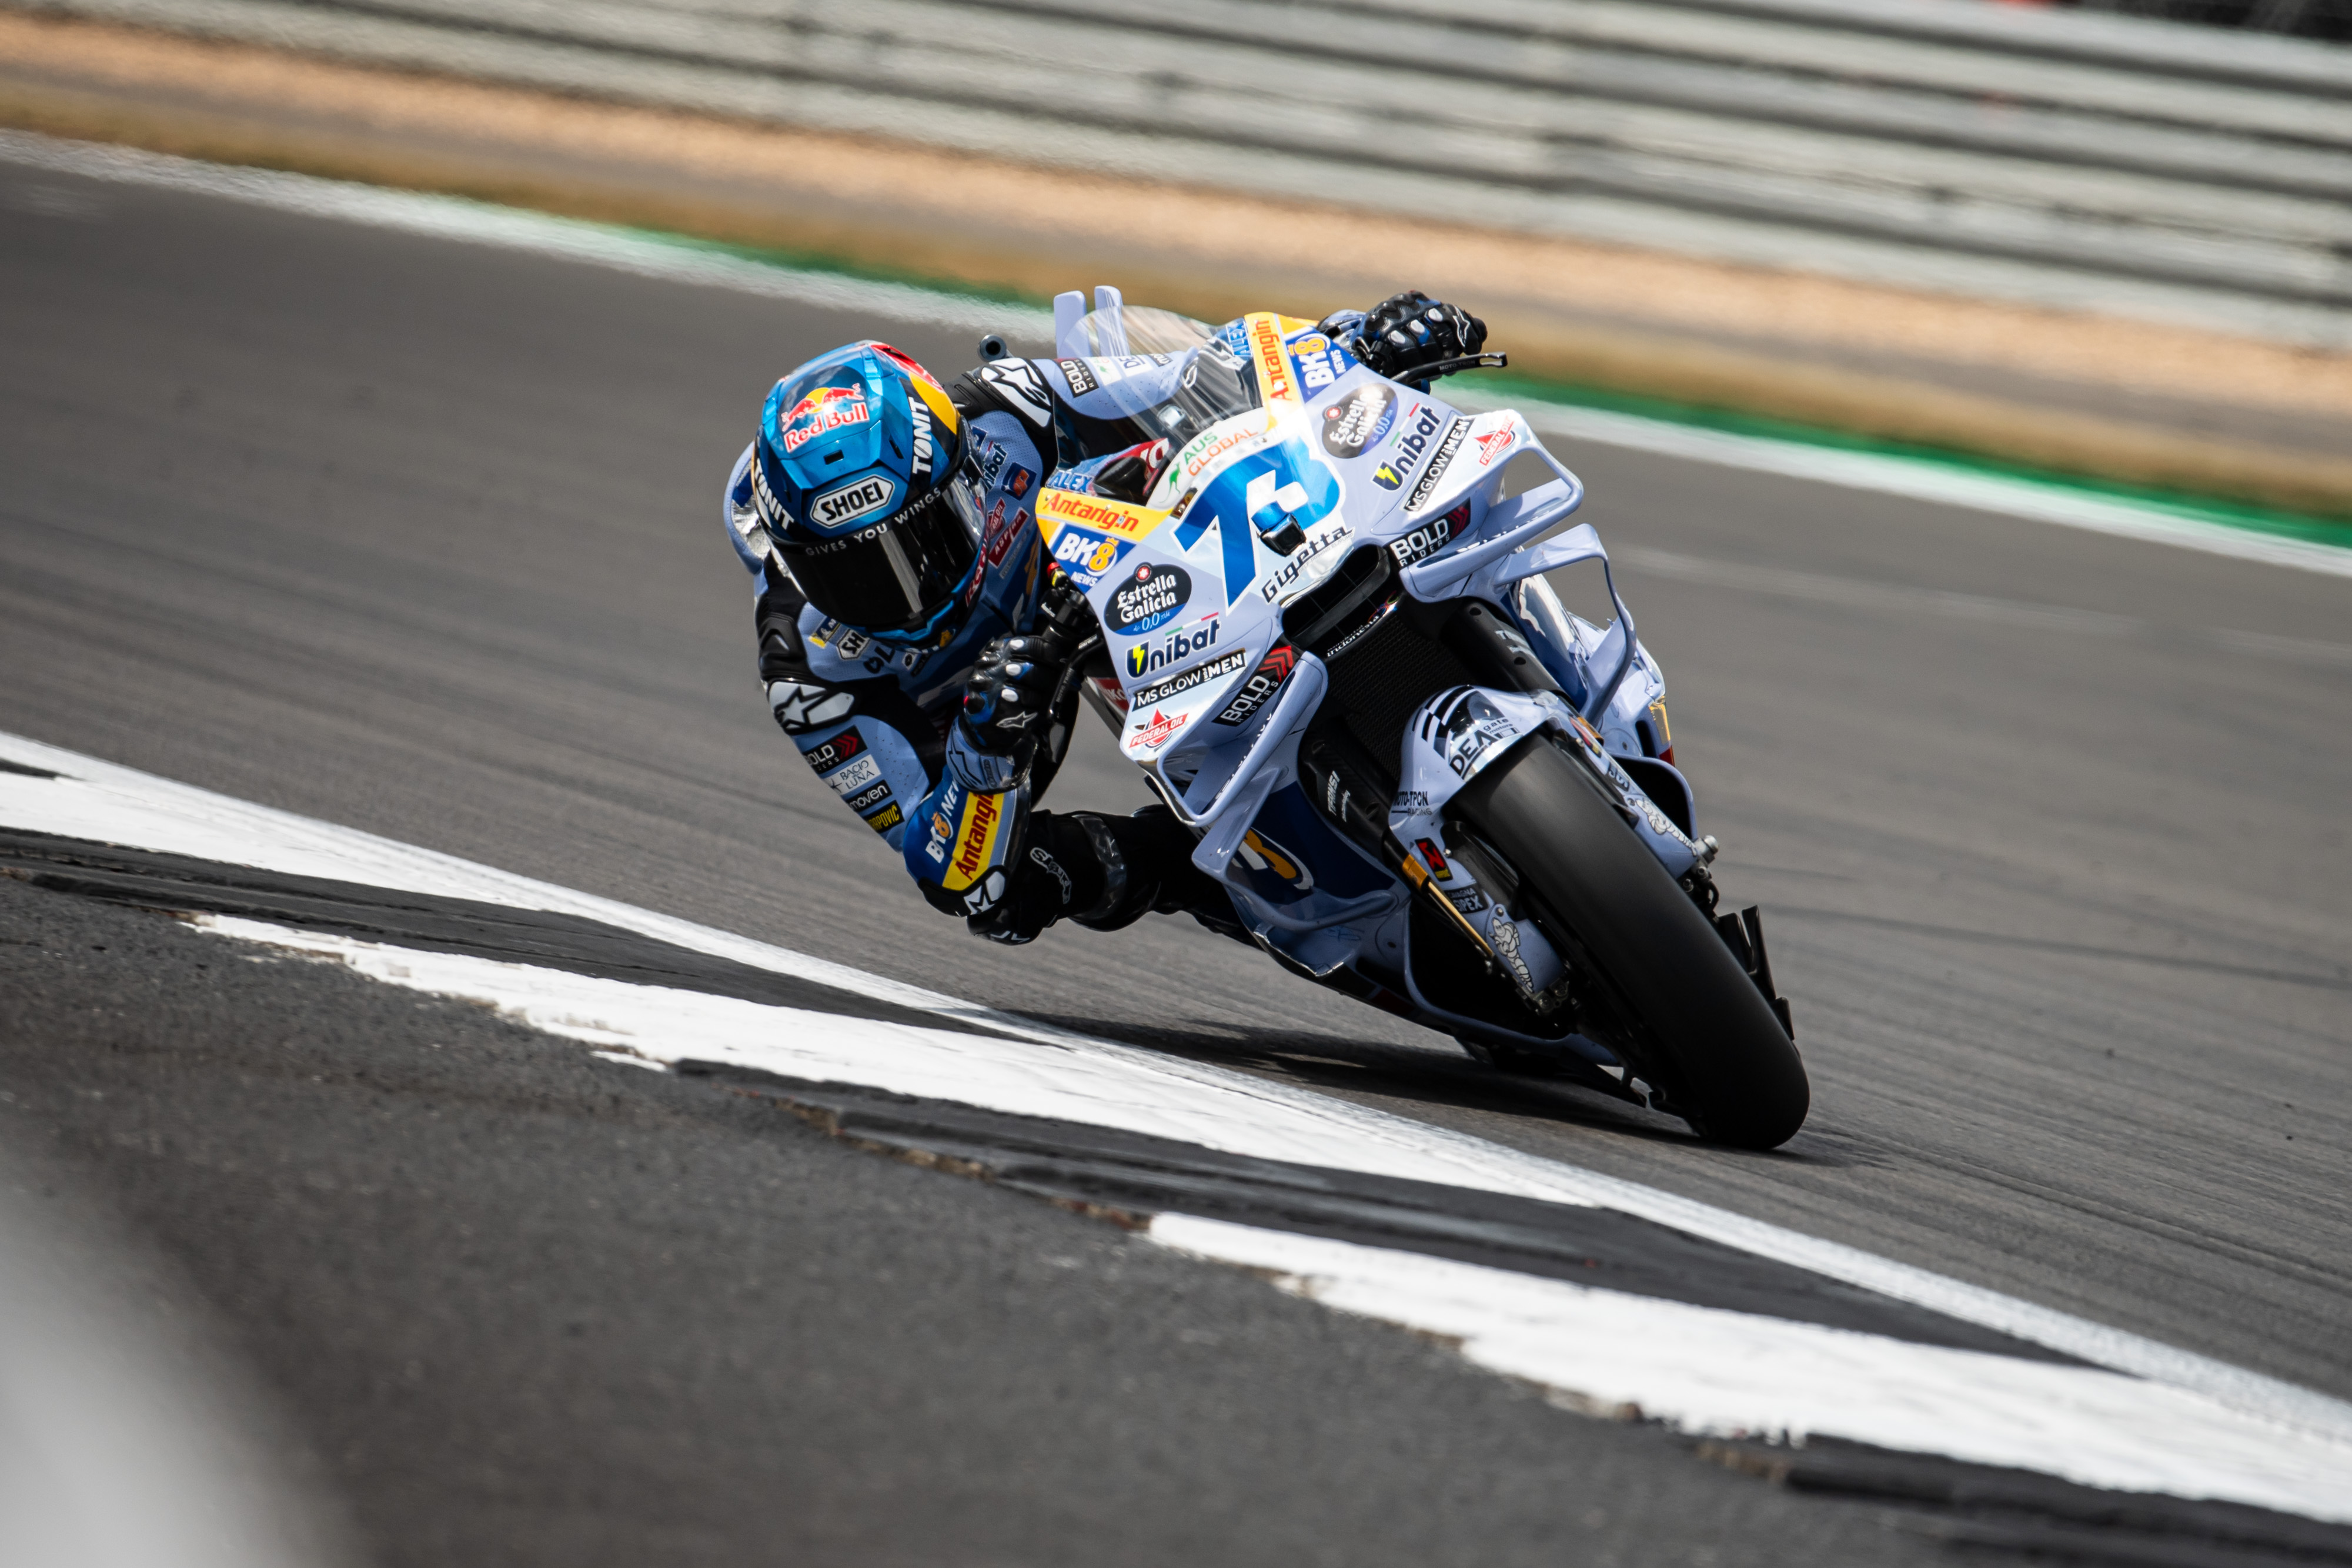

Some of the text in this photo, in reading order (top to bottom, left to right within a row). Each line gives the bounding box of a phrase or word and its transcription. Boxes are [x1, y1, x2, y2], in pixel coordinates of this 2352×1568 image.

[1061, 360, 1088, 394] BOLD
[1252, 320, 1293, 400] Antangin
[1293, 337, 1335, 389] BK8
[1331, 349, 1347, 375] NEWS
[784, 402, 870, 452] Red Bull
[908, 396, 933, 474] TONIT
[1370, 404, 1441, 490] Unibat
[983, 443, 1008, 490] nibat
[1184, 432, 1218, 465] AUS
[1188, 429, 1258, 477] GLOBAL
[1421, 452, 1449, 491] GLOW
[1446, 419, 1471, 450] MEN
[1481, 432, 1504, 465] FEDERAL
[754, 457, 794, 530] TONIT
[820, 481, 884, 521] SHOEI
[1047, 470, 1092, 493] ALEX
[805, 487, 941, 556] GIVES YOU WINGS
[1043, 493, 1139, 532] Antangin
[1055, 533, 1116, 571] BK8
[1390, 519, 1449, 560] BOLD
[1399, 534, 1450, 567] RIDERS
[1071, 571, 1099, 587] NEWS
[1261, 526, 1354, 603] Gigetta
[1117, 574, 1177, 609] Estrella
[1121, 591, 1177, 623] Galicia
[1126, 617, 1221, 679] Unibat
[1137, 690, 1158, 707] MS
[1160, 671, 1201, 697] GLOW
[1207, 653, 1244, 677] MEN
[1220, 676, 1270, 721] BOLD
[1235, 681, 1278, 723] RIDERS
[1132, 718, 1184, 745] FEDERAL OIL
[1483, 718, 1509, 732] gate
[1489, 723, 1513, 734] motors
[840, 760, 869, 781] BACIO
[1449, 730, 1499, 777] DEA
[845, 770, 875, 790] LUNA
[850, 785, 888, 809] moven
[1408, 808, 1433, 816] RACING
[926, 813, 951, 864] BK8
